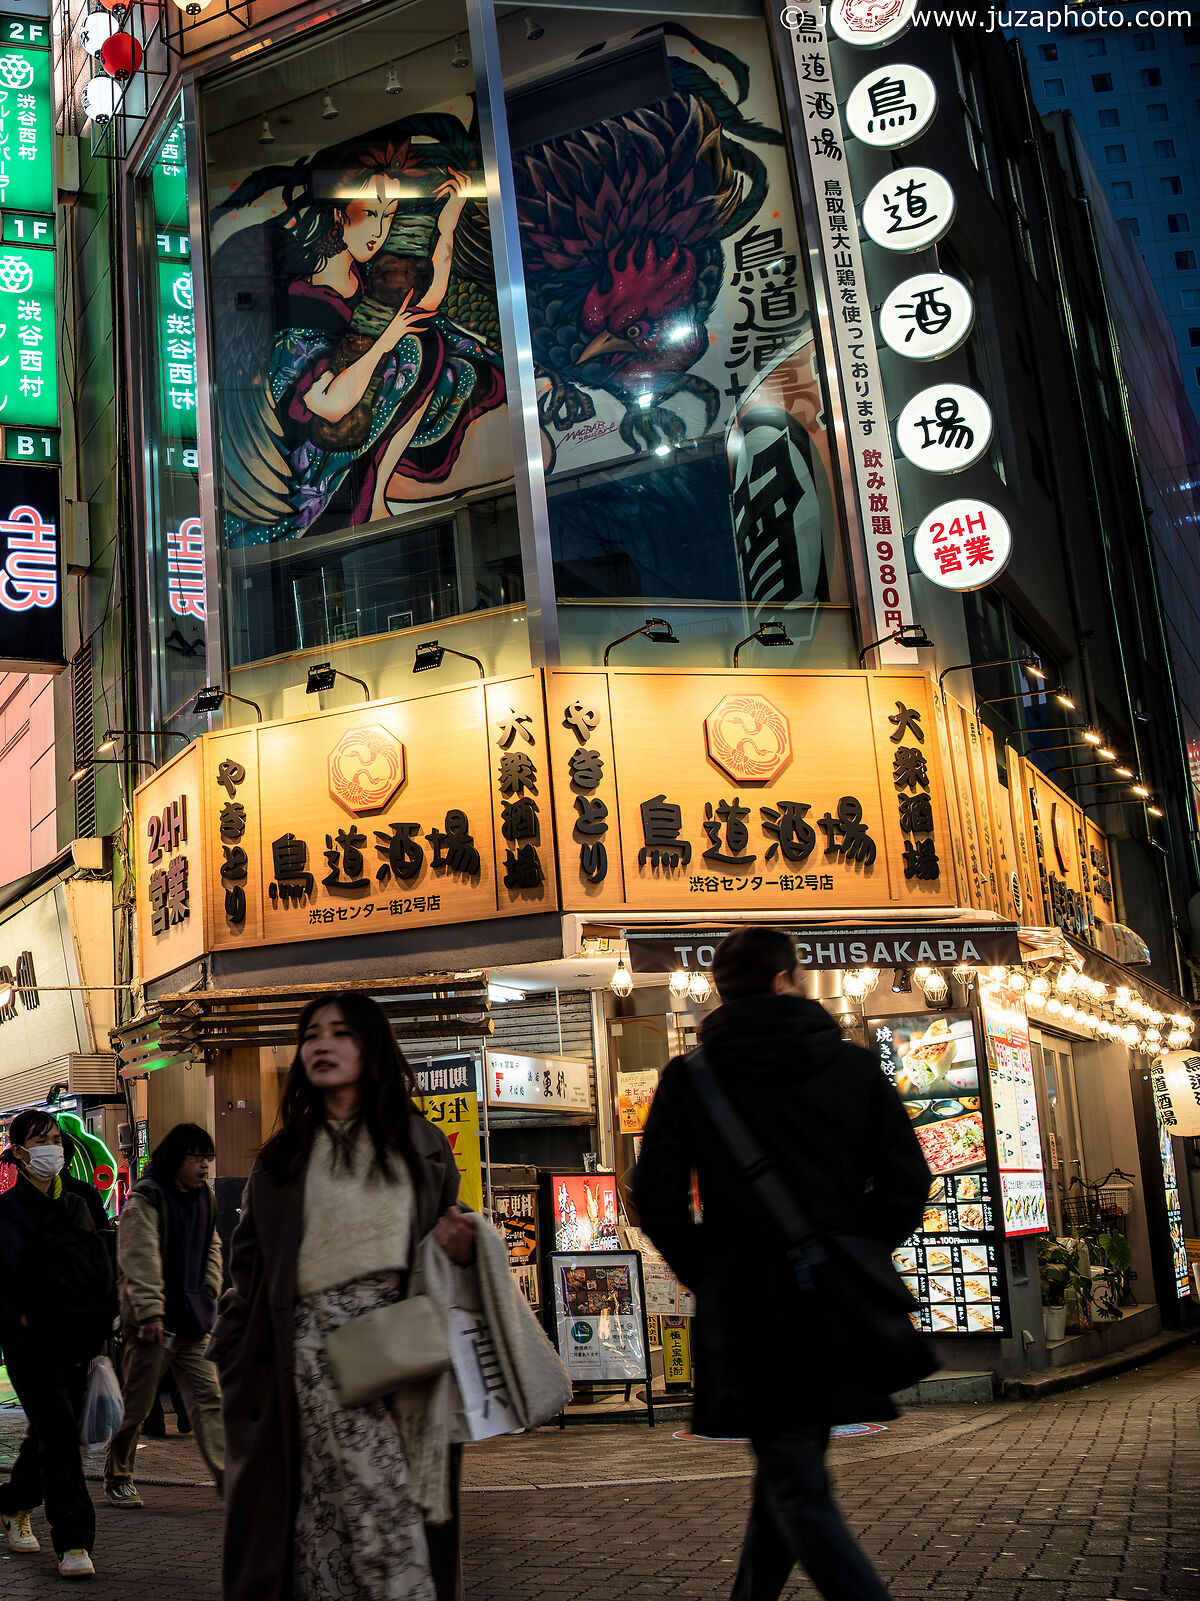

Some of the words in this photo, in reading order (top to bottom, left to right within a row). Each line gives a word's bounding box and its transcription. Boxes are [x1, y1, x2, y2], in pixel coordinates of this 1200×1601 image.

[9, 22, 44, 42] 2F
[793, 11, 843, 162] 鳥道酒場
[17, 93, 38, 160] 渋谷西村
[13, 219, 48, 240] 1F
[824, 179, 876, 437] 鳥取県大山鶏を使っております
[17, 299, 44, 398] 渋谷西村
[16, 435, 51, 457] B1
[861, 448, 893, 536] 飲み放題
[929, 510, 987, 544] 24H
[932, 535, 995, 576] 営業
[875, 541, 904, 645] 980円
[563, 700, 609, 884] やきとり
[888, 700, 940, 881] 大衆酒場
[146, 794, 188, 865] 24H
[216, 757, 248, 924] やきとり
[268, 808, 481, 902] 鳥道酒場
[638, 794, 877, 868] 鳥道酒場
[148, 853, 191, 937] 営業
[308, 894, 442, 926] 渋谷センター街2号店
[689, 873, 835, 893] 渋谷センター街2号店
[674, 939, 981, 969] TOCHISAKABA
[875, 1026, 899, 1087] 焼き餃
[625, 1087, 657, 1097] 生ビール
[669, 1330, 685, 1377] 極上宝焼酎
